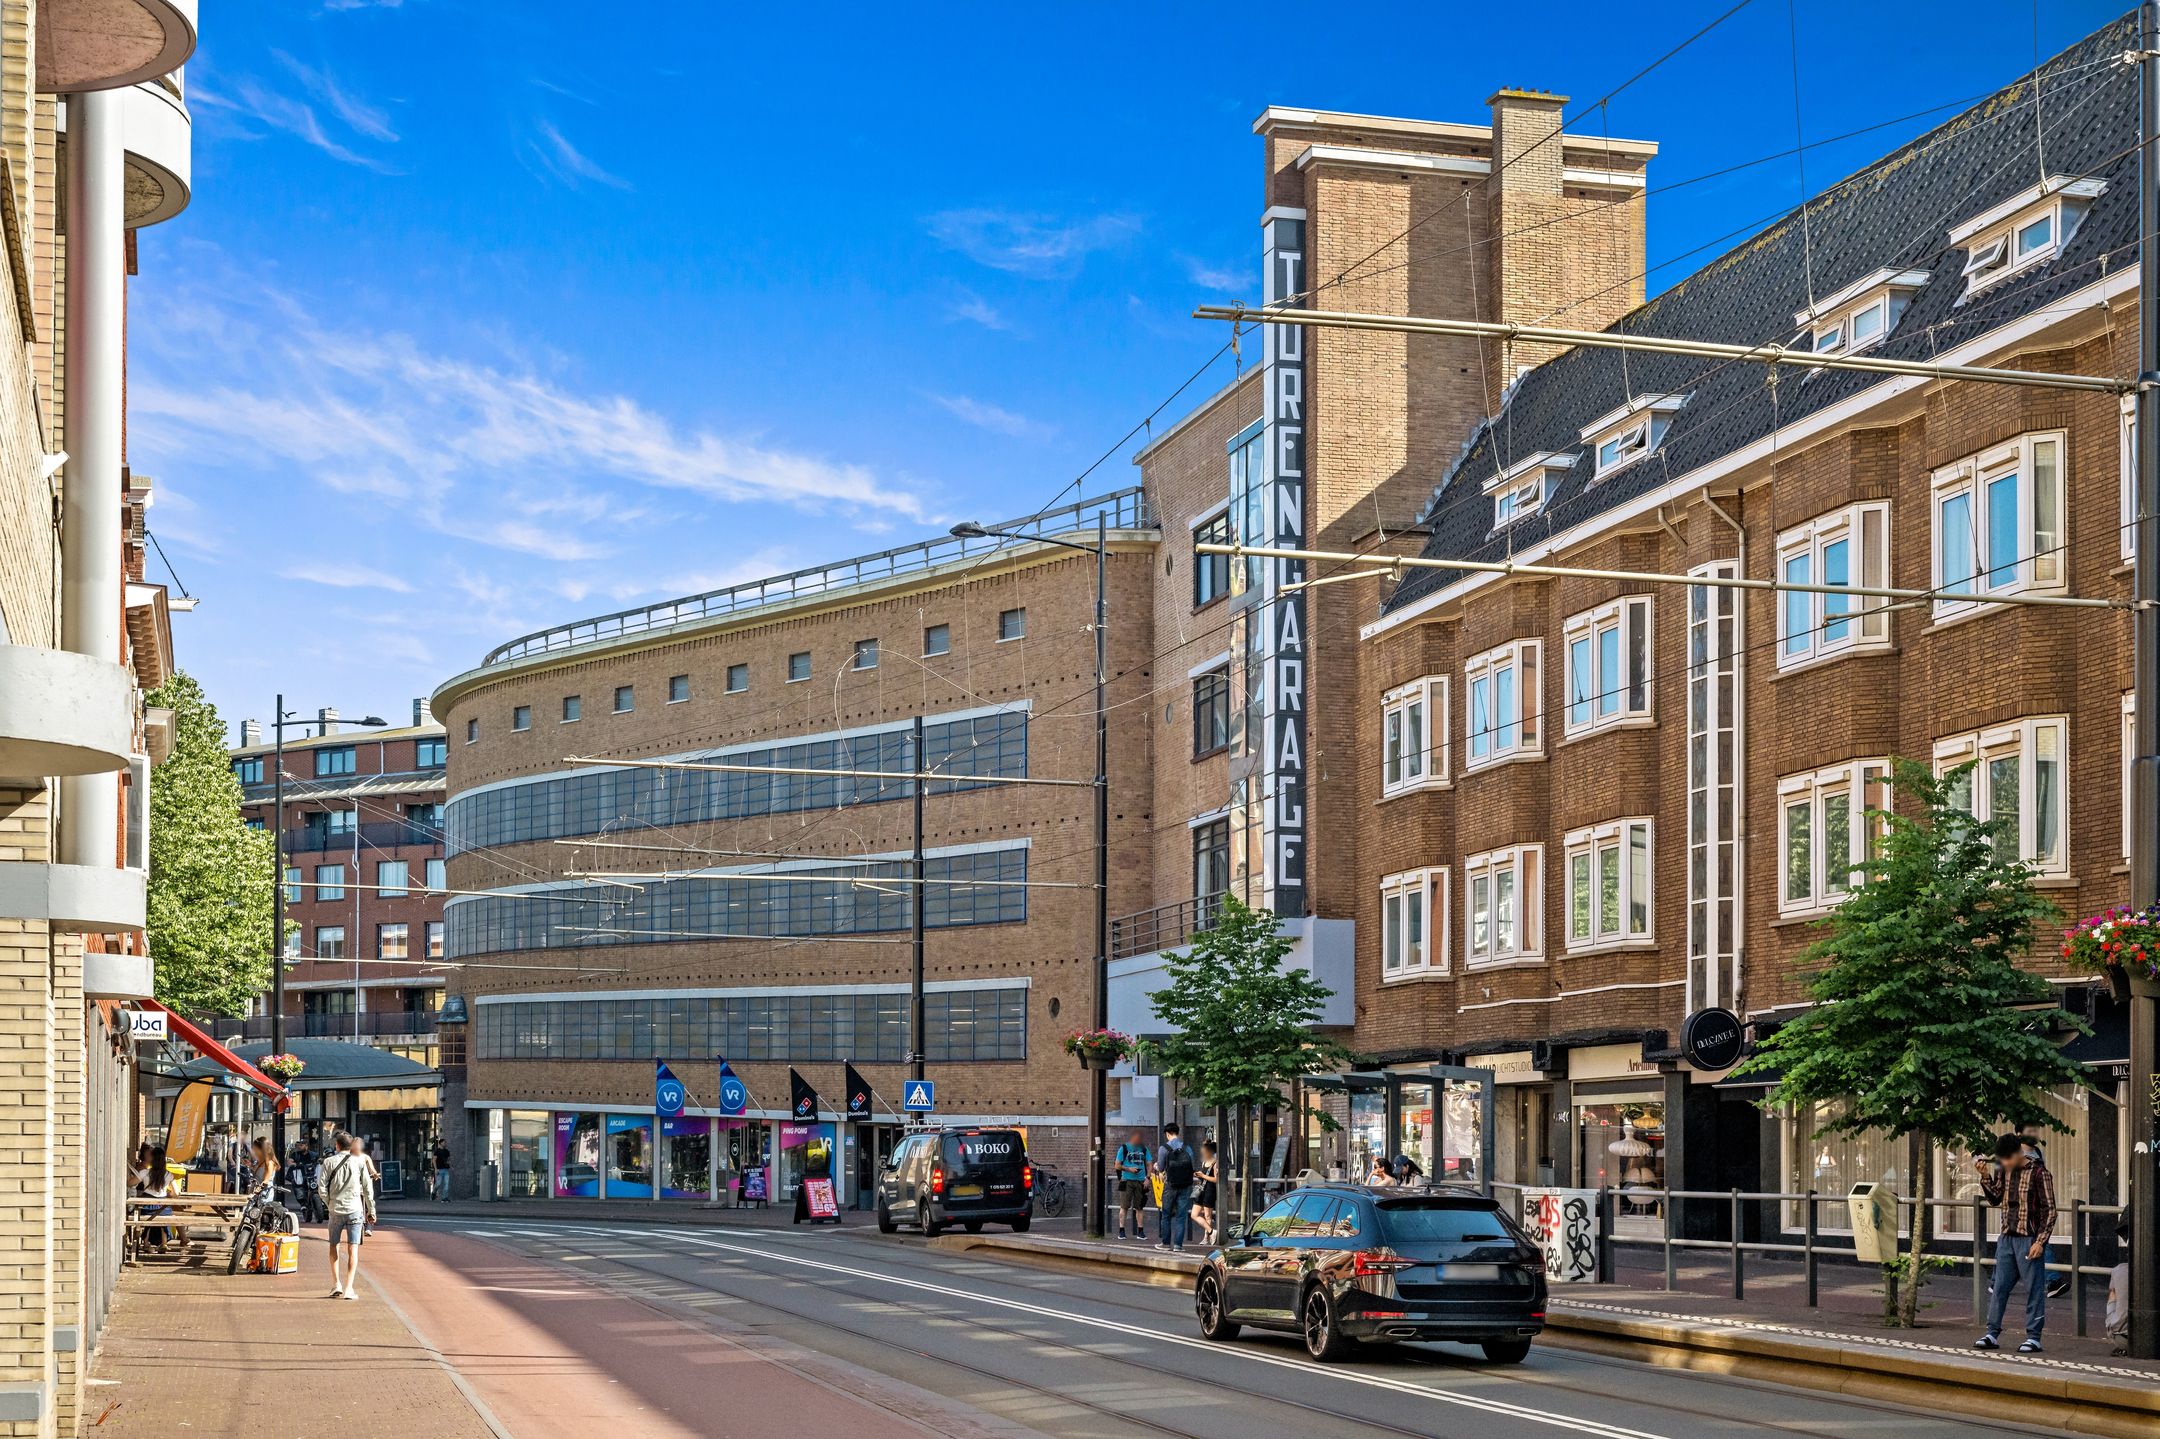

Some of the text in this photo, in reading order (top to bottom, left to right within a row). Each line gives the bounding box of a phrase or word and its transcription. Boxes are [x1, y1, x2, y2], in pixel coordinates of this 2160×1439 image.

[663, 1091, 678, 1102] VR
[726, 1089, 740, 1100] VR
[794, 1127, 808, 1135] PONG
[820, 1137, 833, 1153] VR
[974, 1143, 1010, 1154] BOKO
[558, 1176, 568, 1190] VR
